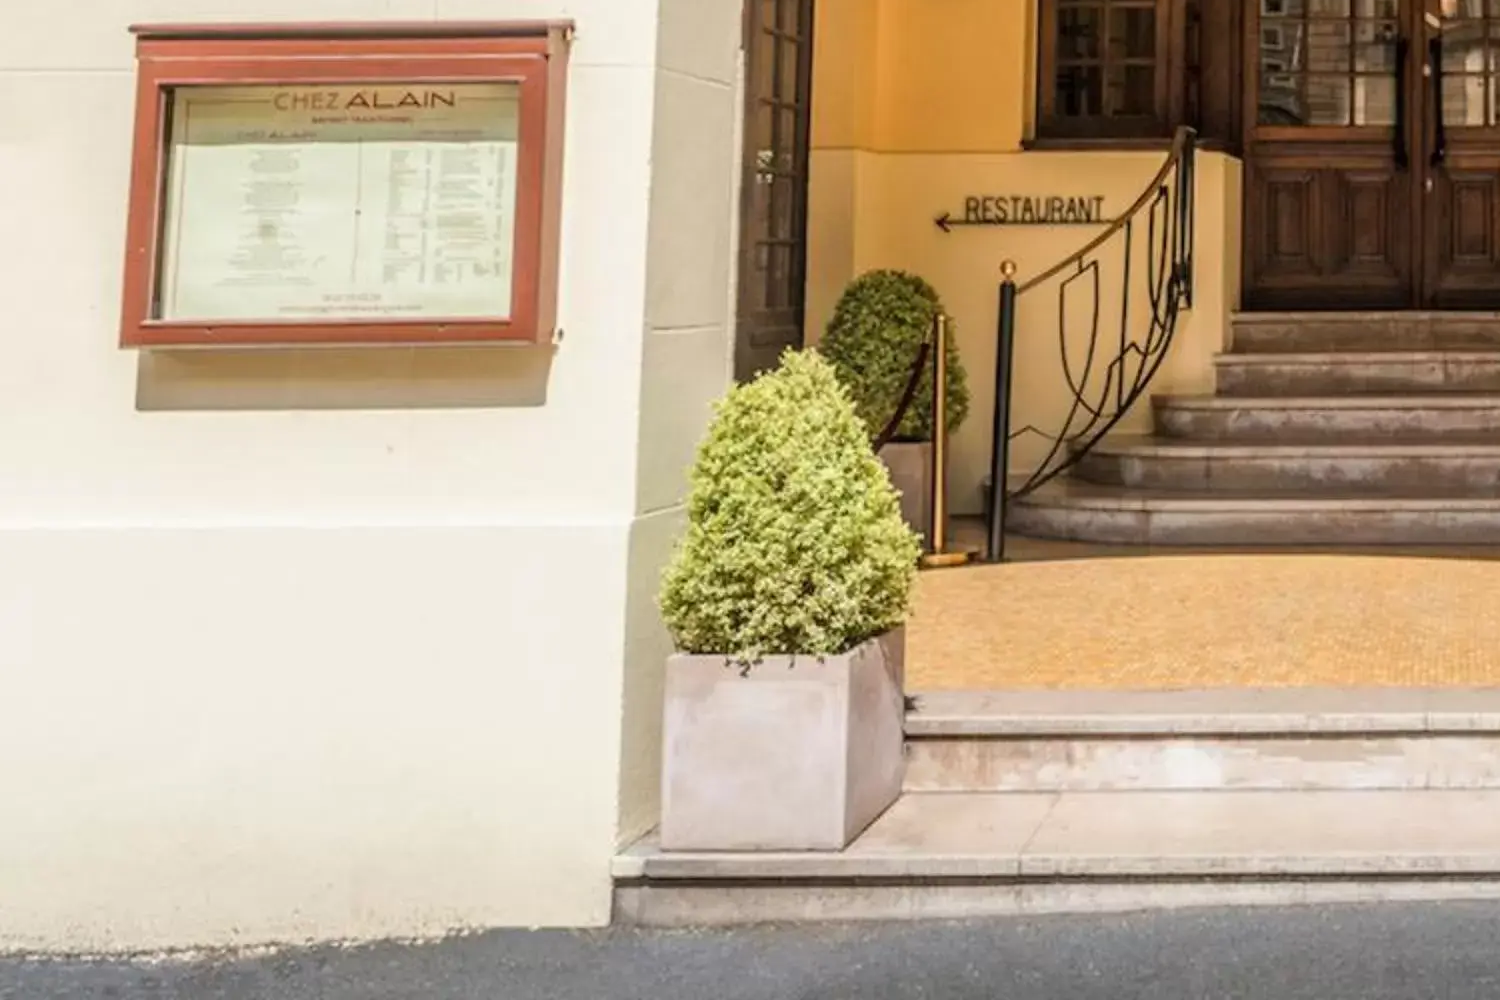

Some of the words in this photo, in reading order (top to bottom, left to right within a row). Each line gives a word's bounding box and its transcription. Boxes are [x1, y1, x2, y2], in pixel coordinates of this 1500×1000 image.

[273, 91, 340, 111] CHEZ
[345, 91, 456, 110] ALAIN
[965, 195, 1104, 224] RESTAURANT
